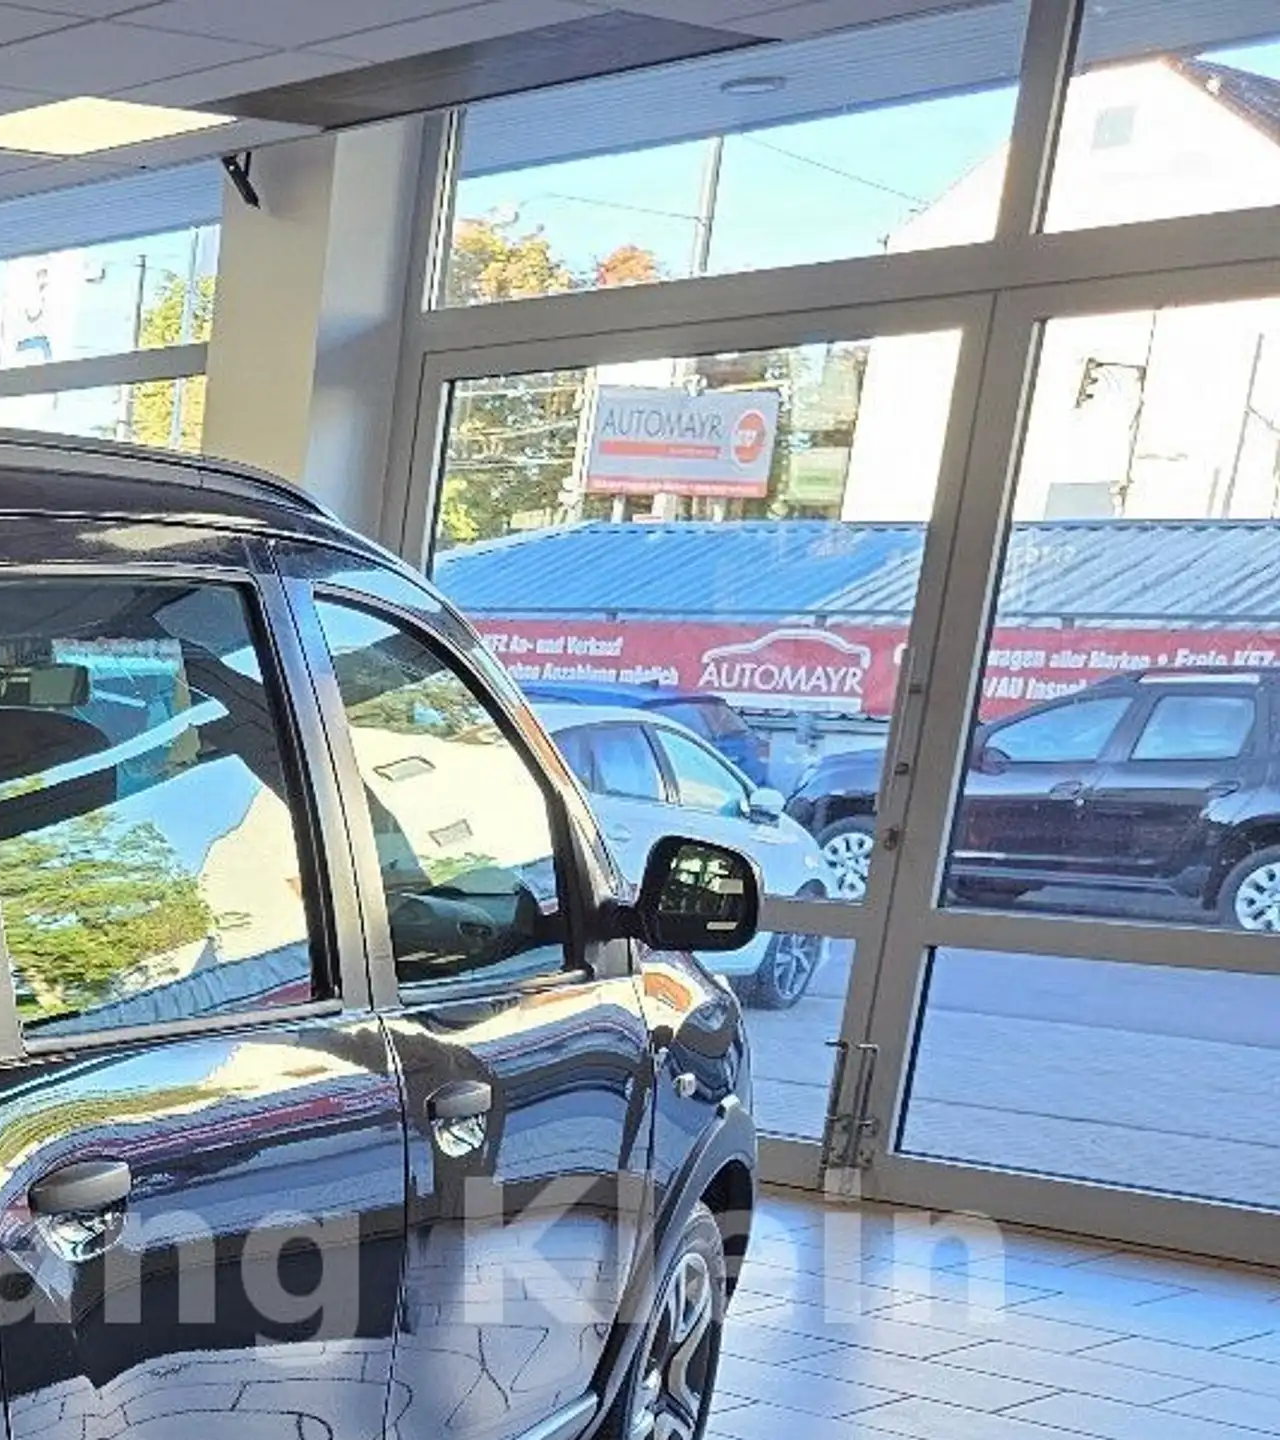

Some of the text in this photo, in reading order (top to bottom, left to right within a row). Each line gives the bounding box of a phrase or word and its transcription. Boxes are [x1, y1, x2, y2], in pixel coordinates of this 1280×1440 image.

[601, 407, 723, 440] AUTOMAYR
[567, 635, 624, 656] Verkauf
[698, 661, 864, 694] AUTOMAYR
